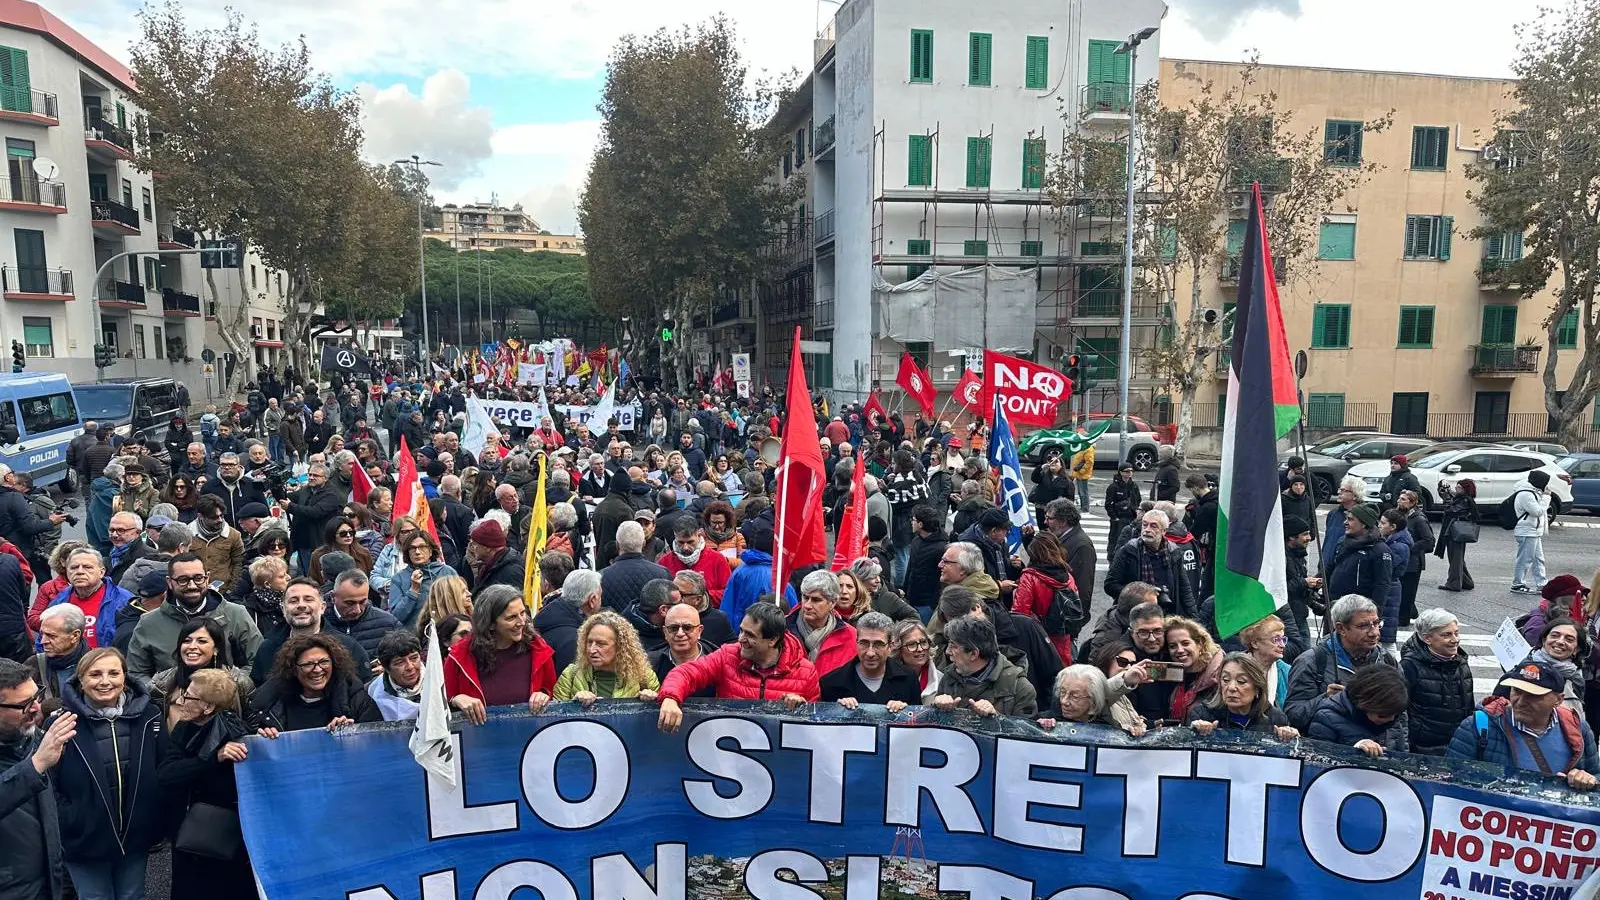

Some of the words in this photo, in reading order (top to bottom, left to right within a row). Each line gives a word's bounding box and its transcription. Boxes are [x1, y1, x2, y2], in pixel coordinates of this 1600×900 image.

[29, 449, 59, 465] POLIZIA
[424, 718, 631, 841] LO
[681, 715, 1428, 883] STRETTO
[1460, 806, 1597, 852] CORTEO
[1430, 828, 1484, 862] NO
[1490, 840, 1600, 880] PONT
[1440, 866, 1461, 888] A
[1469, 871, 1573, 900] MESSIN
